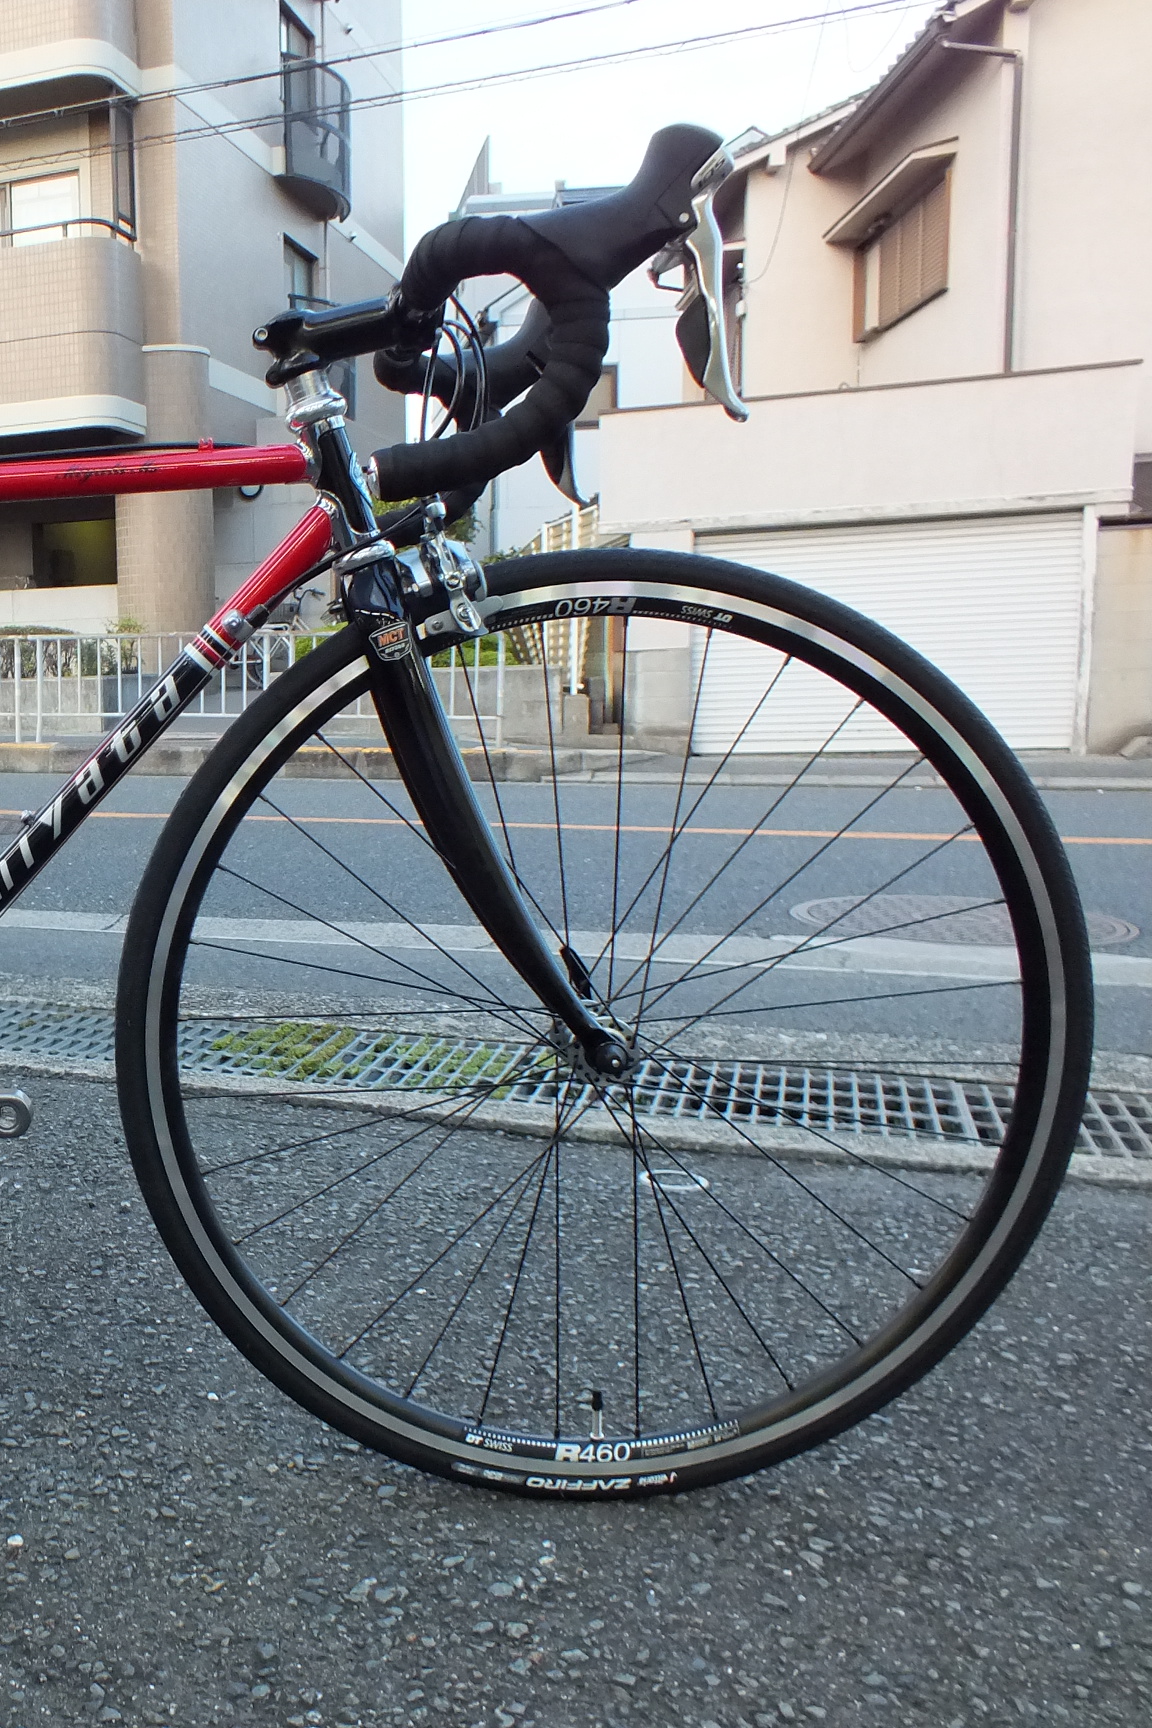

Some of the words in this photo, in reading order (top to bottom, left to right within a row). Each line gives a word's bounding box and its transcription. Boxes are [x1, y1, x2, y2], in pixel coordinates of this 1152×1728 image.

[554, 597, 637, 618] R460
[681, 605, 713, 619] SWISS
[714, 613, 734, 623] DT
[377, 628, 405, 647] MCT
[465, 1433, 484, 1446] DT
[483, 1438, 514, 1452] SWISS
[555, 1443, 630, 1463] R460
[525, 1476, 632, 1492] ZAFFIRO
